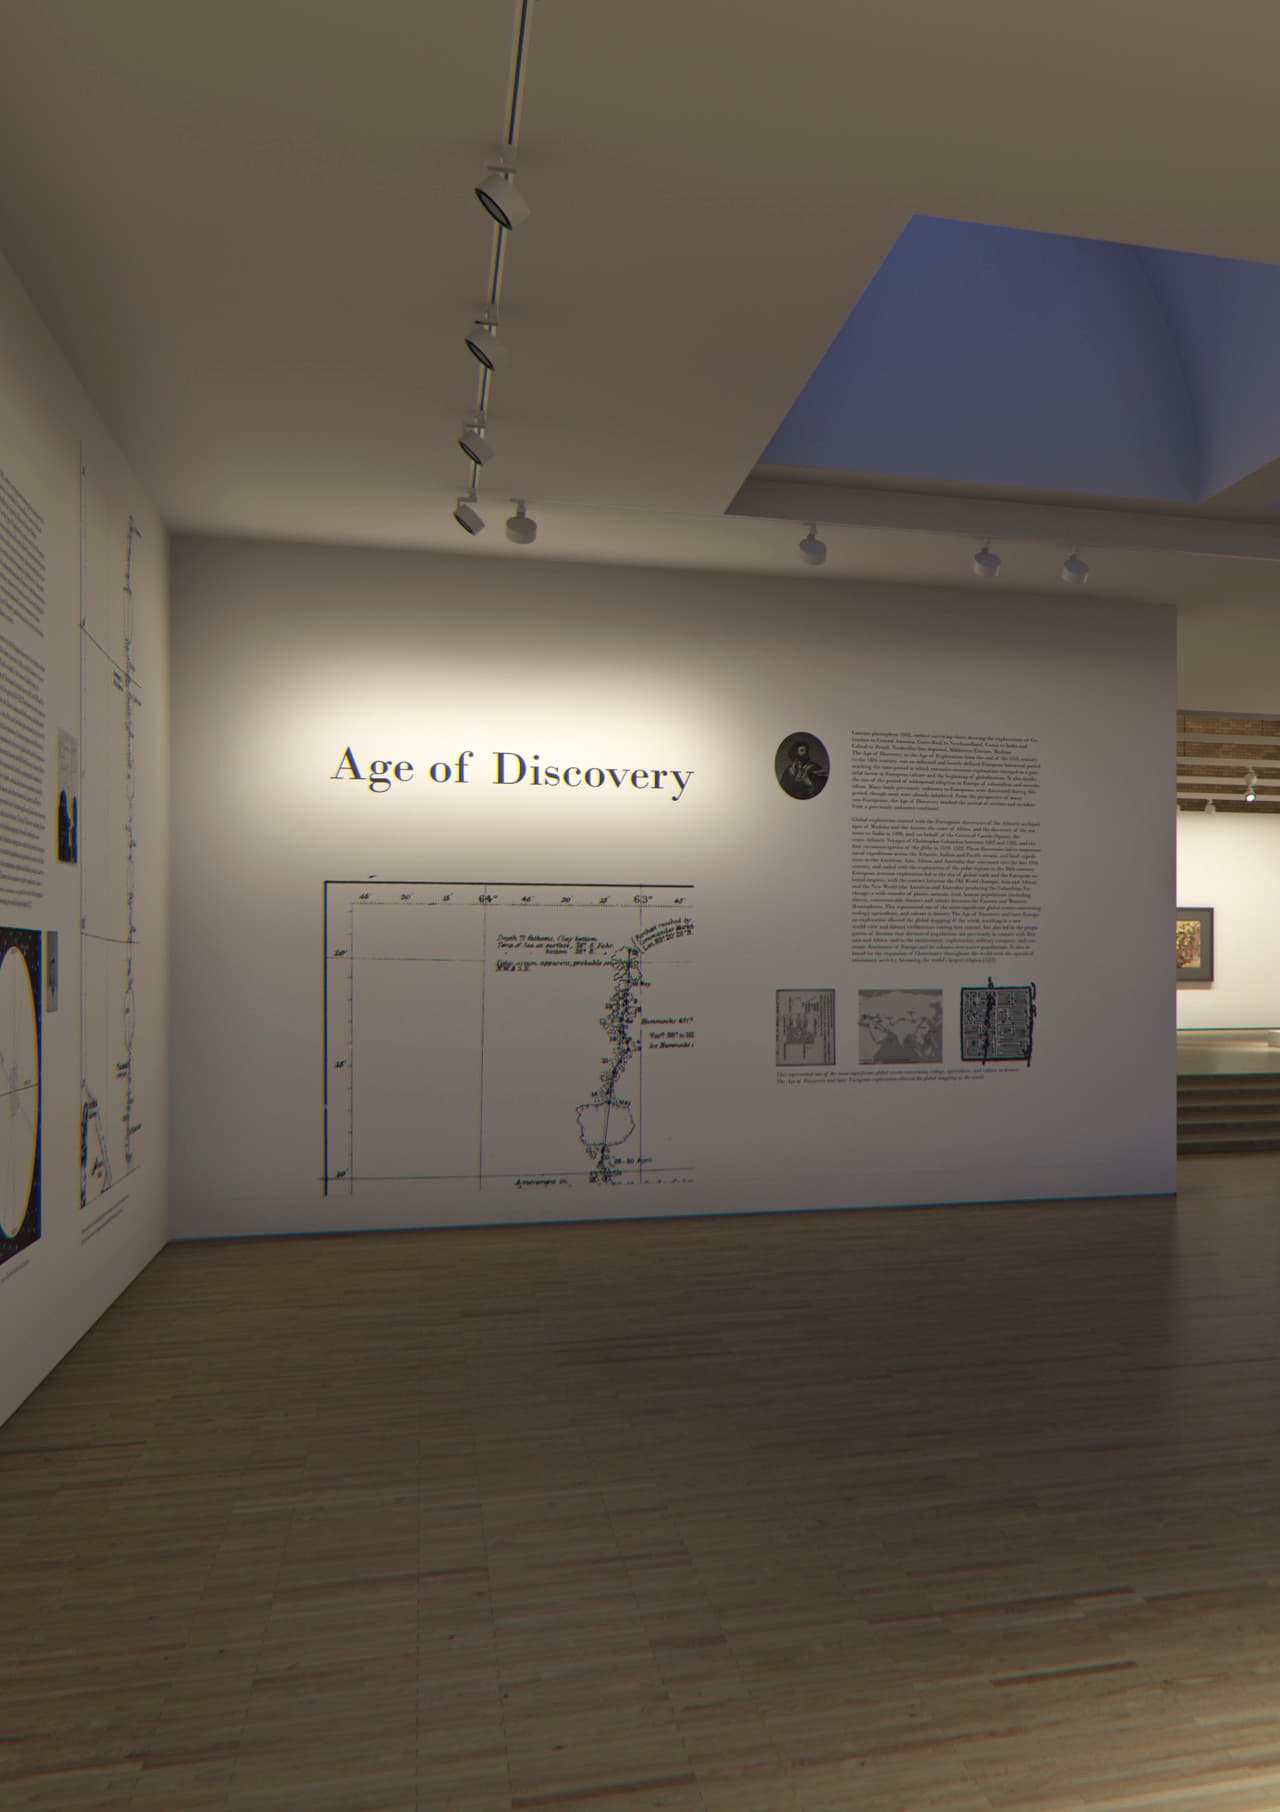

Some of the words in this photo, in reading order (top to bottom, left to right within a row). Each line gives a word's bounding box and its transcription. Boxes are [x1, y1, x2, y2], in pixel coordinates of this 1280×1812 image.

[330, 746, 414, 793] Age
[428, 750, 473, 784] of
[492, 751, 696, 801] Discovery
